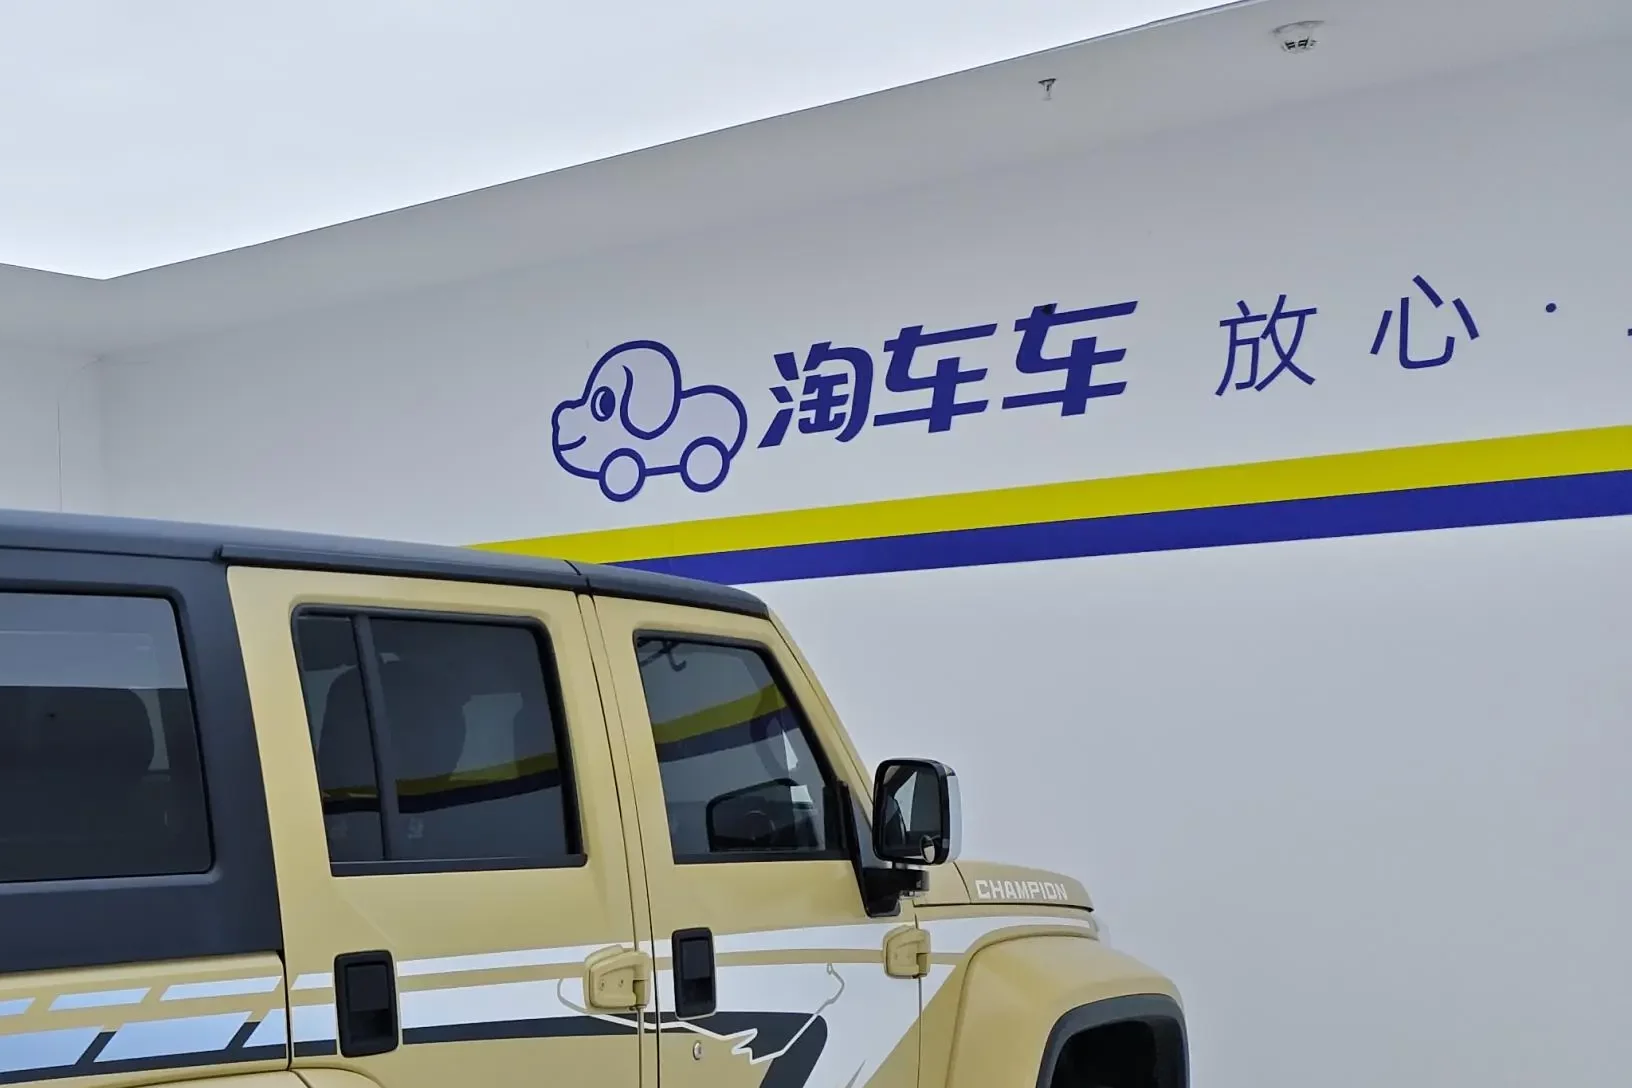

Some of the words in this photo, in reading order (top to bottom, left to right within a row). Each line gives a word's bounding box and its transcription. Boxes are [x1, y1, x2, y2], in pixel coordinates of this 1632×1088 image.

[758, 301, 1138, 447] 淘车车
[975, 879, 1068, 901] CHAMPION
